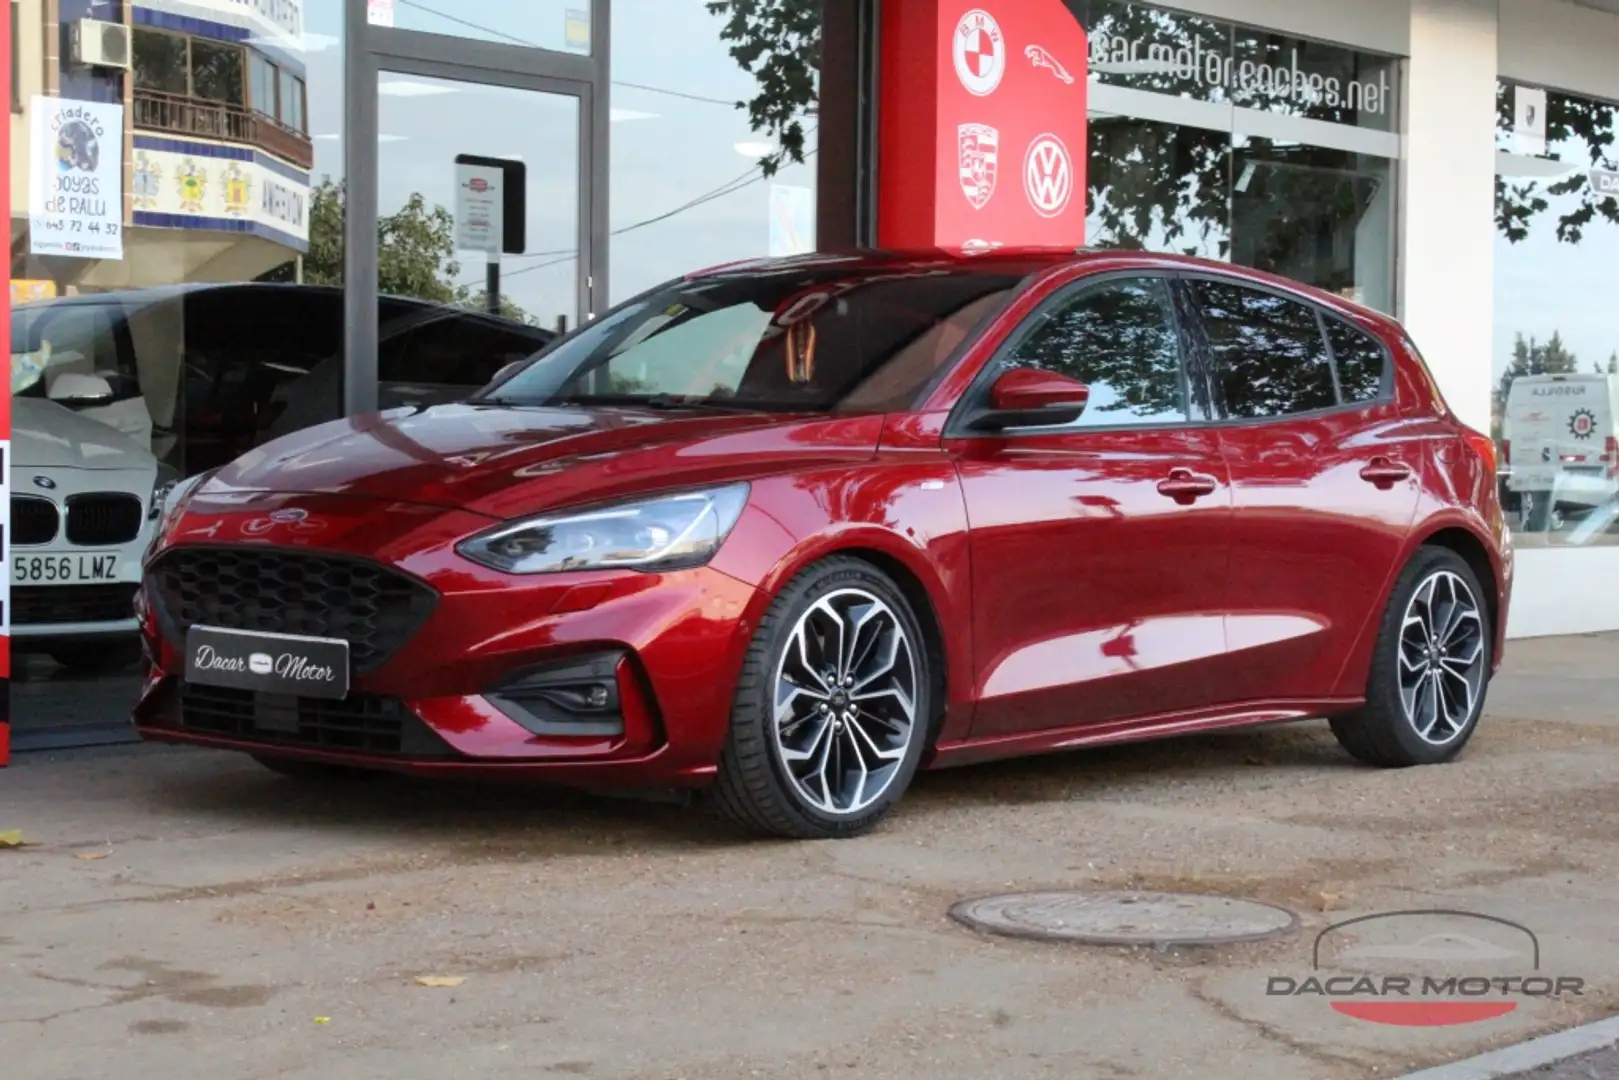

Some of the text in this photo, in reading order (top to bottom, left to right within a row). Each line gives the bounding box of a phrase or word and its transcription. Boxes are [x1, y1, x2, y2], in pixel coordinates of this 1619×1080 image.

[15, 556, 117, 581] 5856 LMZ
[194, 644, 336, 682] Dacar Motor
